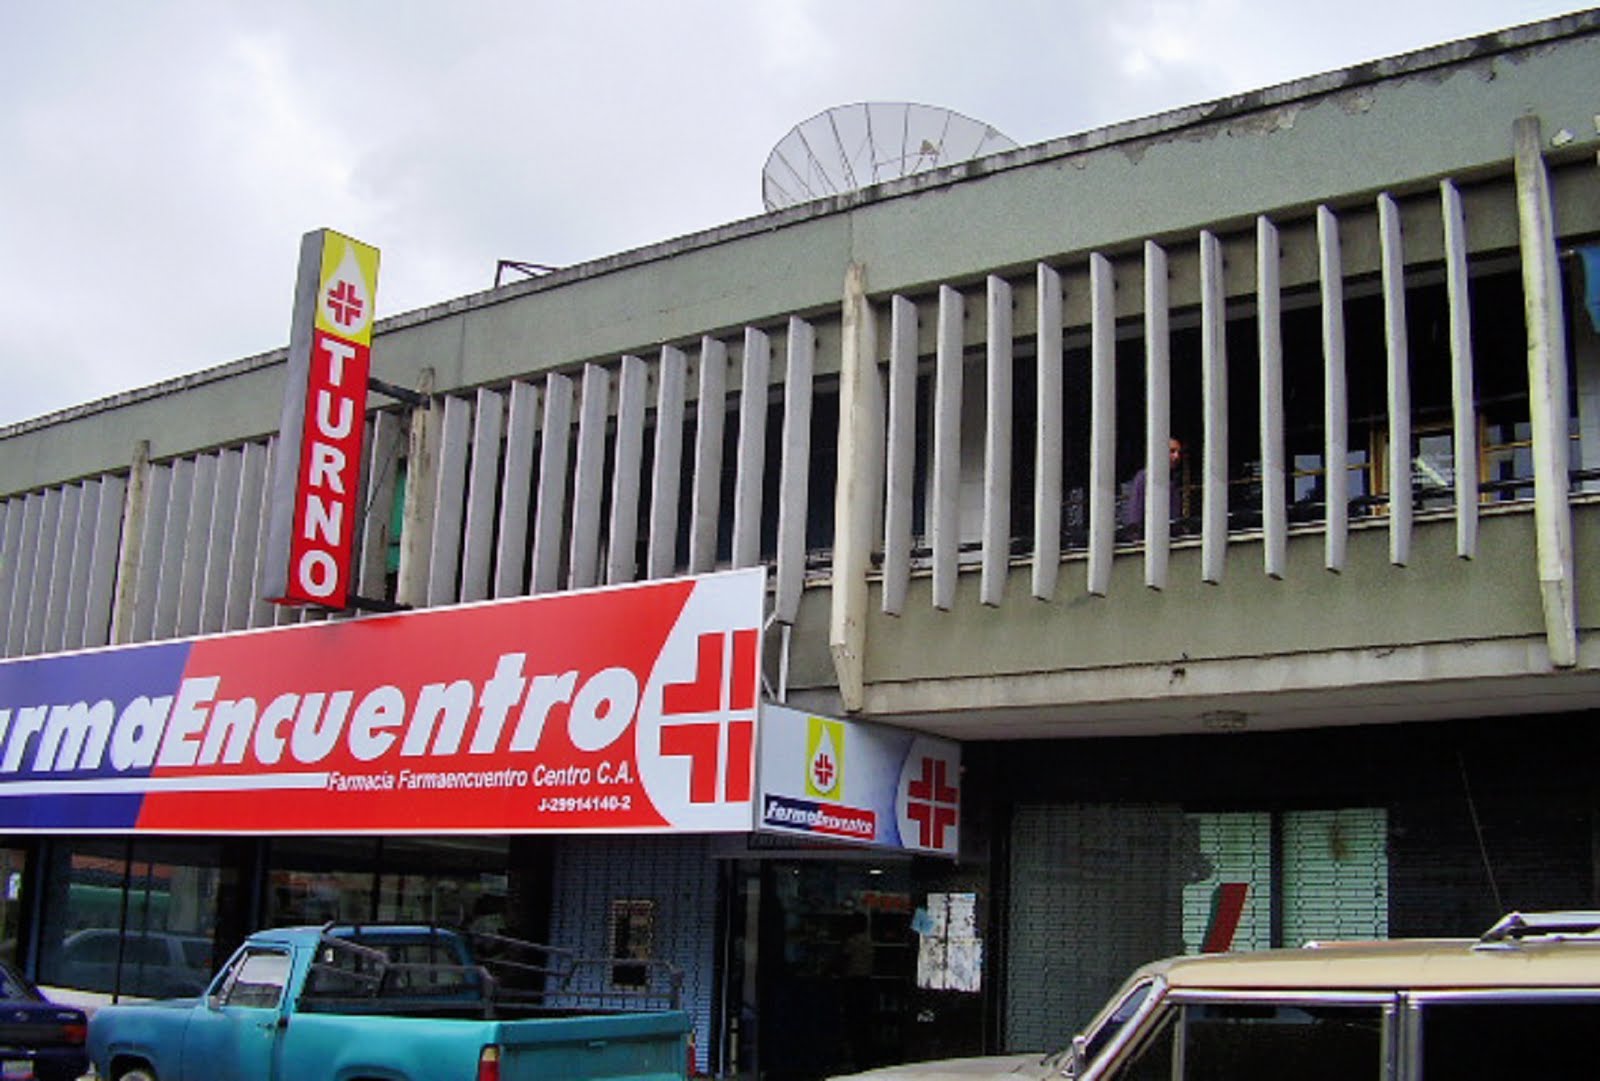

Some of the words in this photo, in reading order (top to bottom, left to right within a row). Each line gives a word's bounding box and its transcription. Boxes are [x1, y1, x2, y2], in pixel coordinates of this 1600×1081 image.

[299, 336, 356, 598] TURNO
[0, 652, 640, 773] rmaEncuentro
[328, 770, 395, 791] Farmacia
[398, 768, 527, 790] Farmaencuentro
[532, 764, 591, 786] Centro
[596, 760, 635, 785] C.A.
